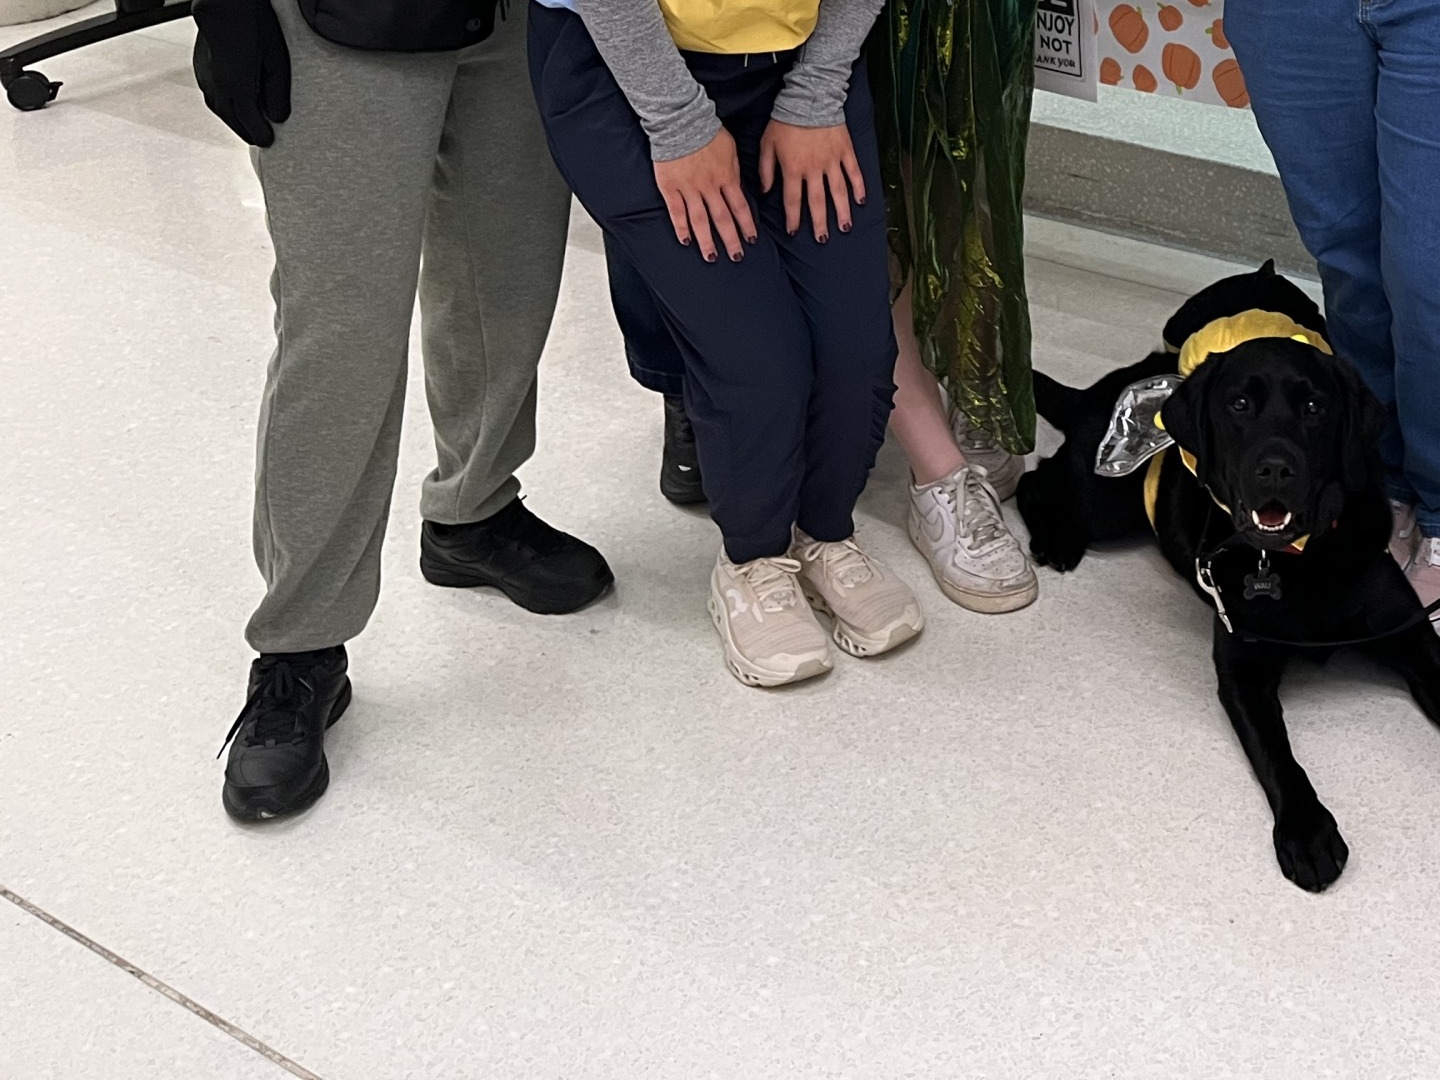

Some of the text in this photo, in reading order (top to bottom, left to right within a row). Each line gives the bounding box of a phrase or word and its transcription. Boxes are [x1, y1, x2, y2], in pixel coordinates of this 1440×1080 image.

[1037, 11, 1075, 36] NJOY
[1040, 34, 1072, 54] NOT
[1036, 55, 1056, 66] ANK
